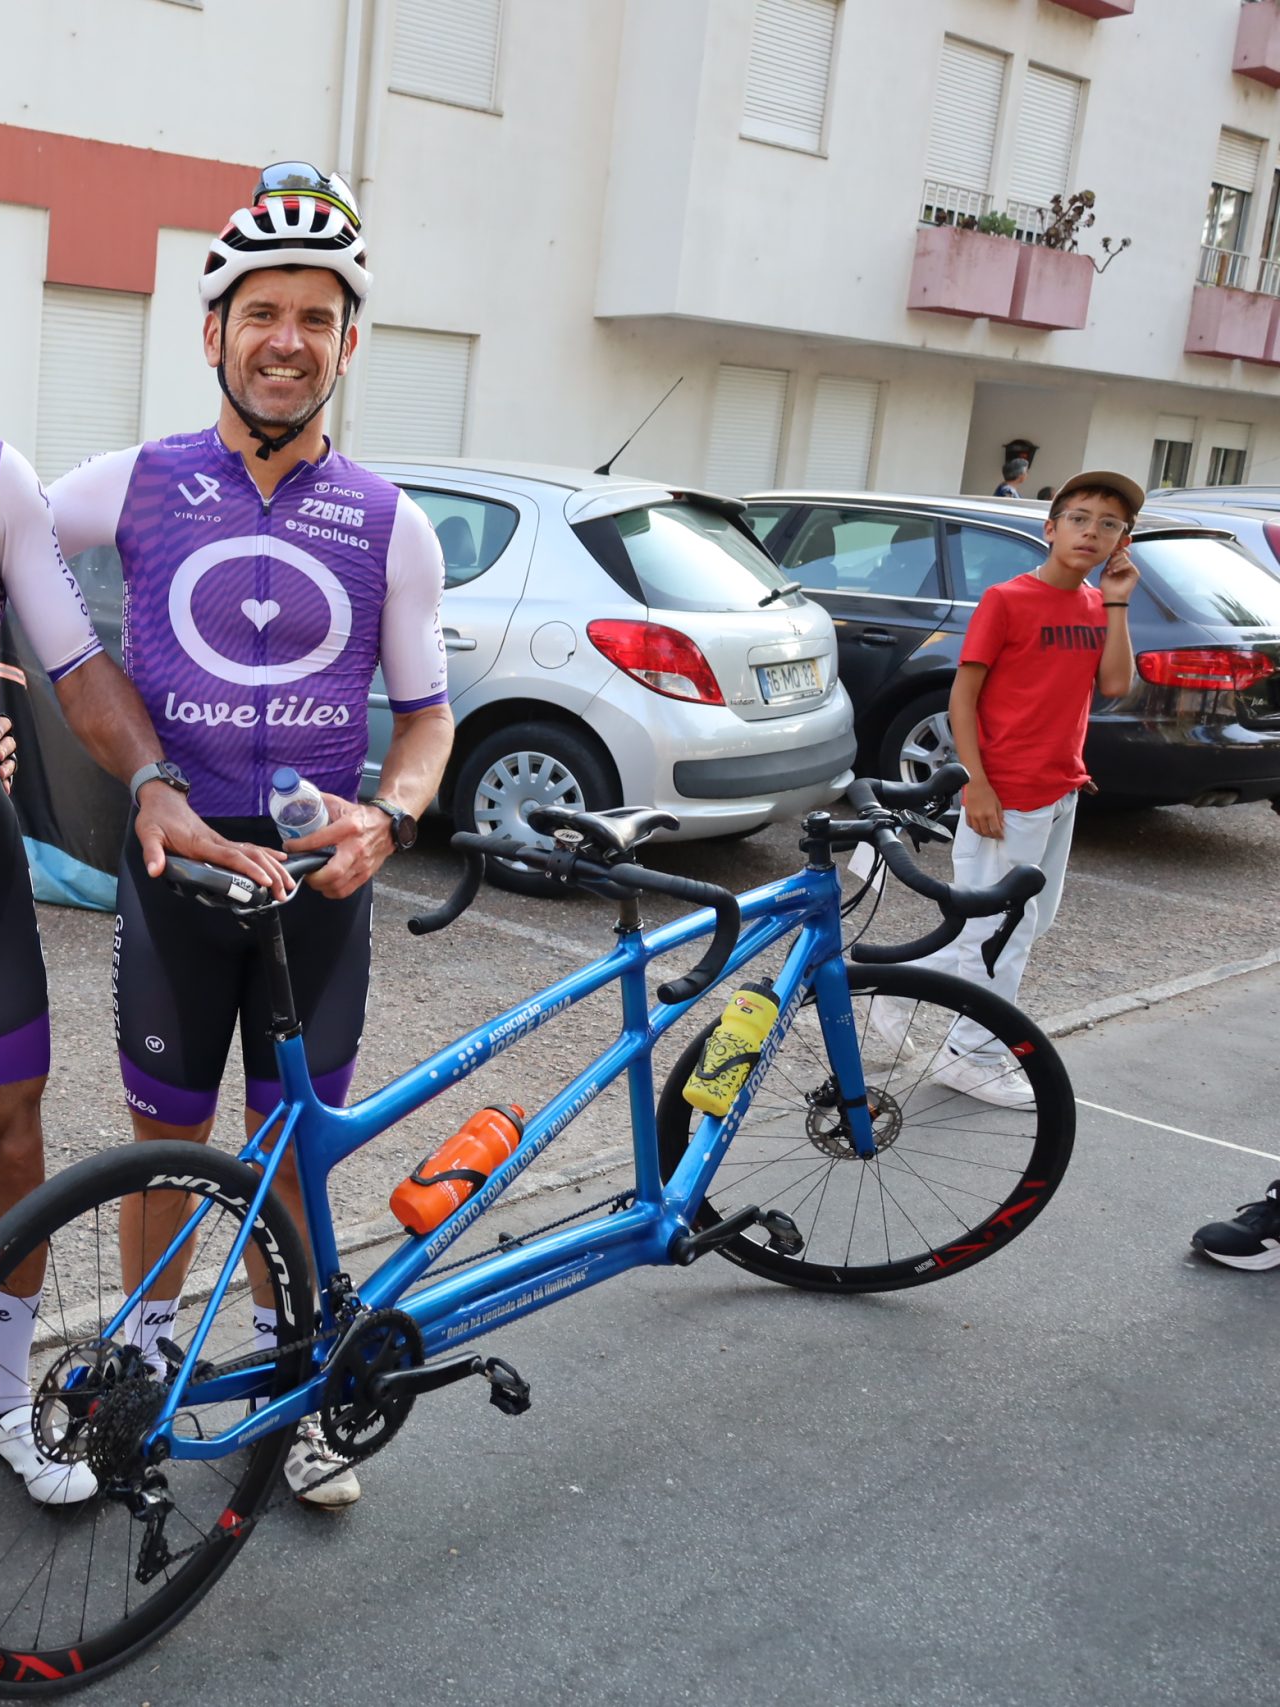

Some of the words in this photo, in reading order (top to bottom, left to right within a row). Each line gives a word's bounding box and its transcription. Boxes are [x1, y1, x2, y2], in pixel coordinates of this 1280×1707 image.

[332, 486, 365, 500] PACTO
[173, 511, 222, 524] VIRIATO
[297, 498, 366, 528] 226ERS
[285, 519, 370, 551] expoluso
[164, 692, 262, 728] love
[265, 695, 350, 727] tiles
[780, 983, 809, 1031] PINA
[426, 1205, 481, 1261] DESPORTO
[480, 1178, 504, 1208] COM
[502, 1147, 535, 1183] VALOR
[534, 1134, 549, 1152] DE
[548, 1081, 600, 1138] IGUALDADE
[482, 1300, 516, 1325] vontade
[517, 1292, 533, 1308] não
